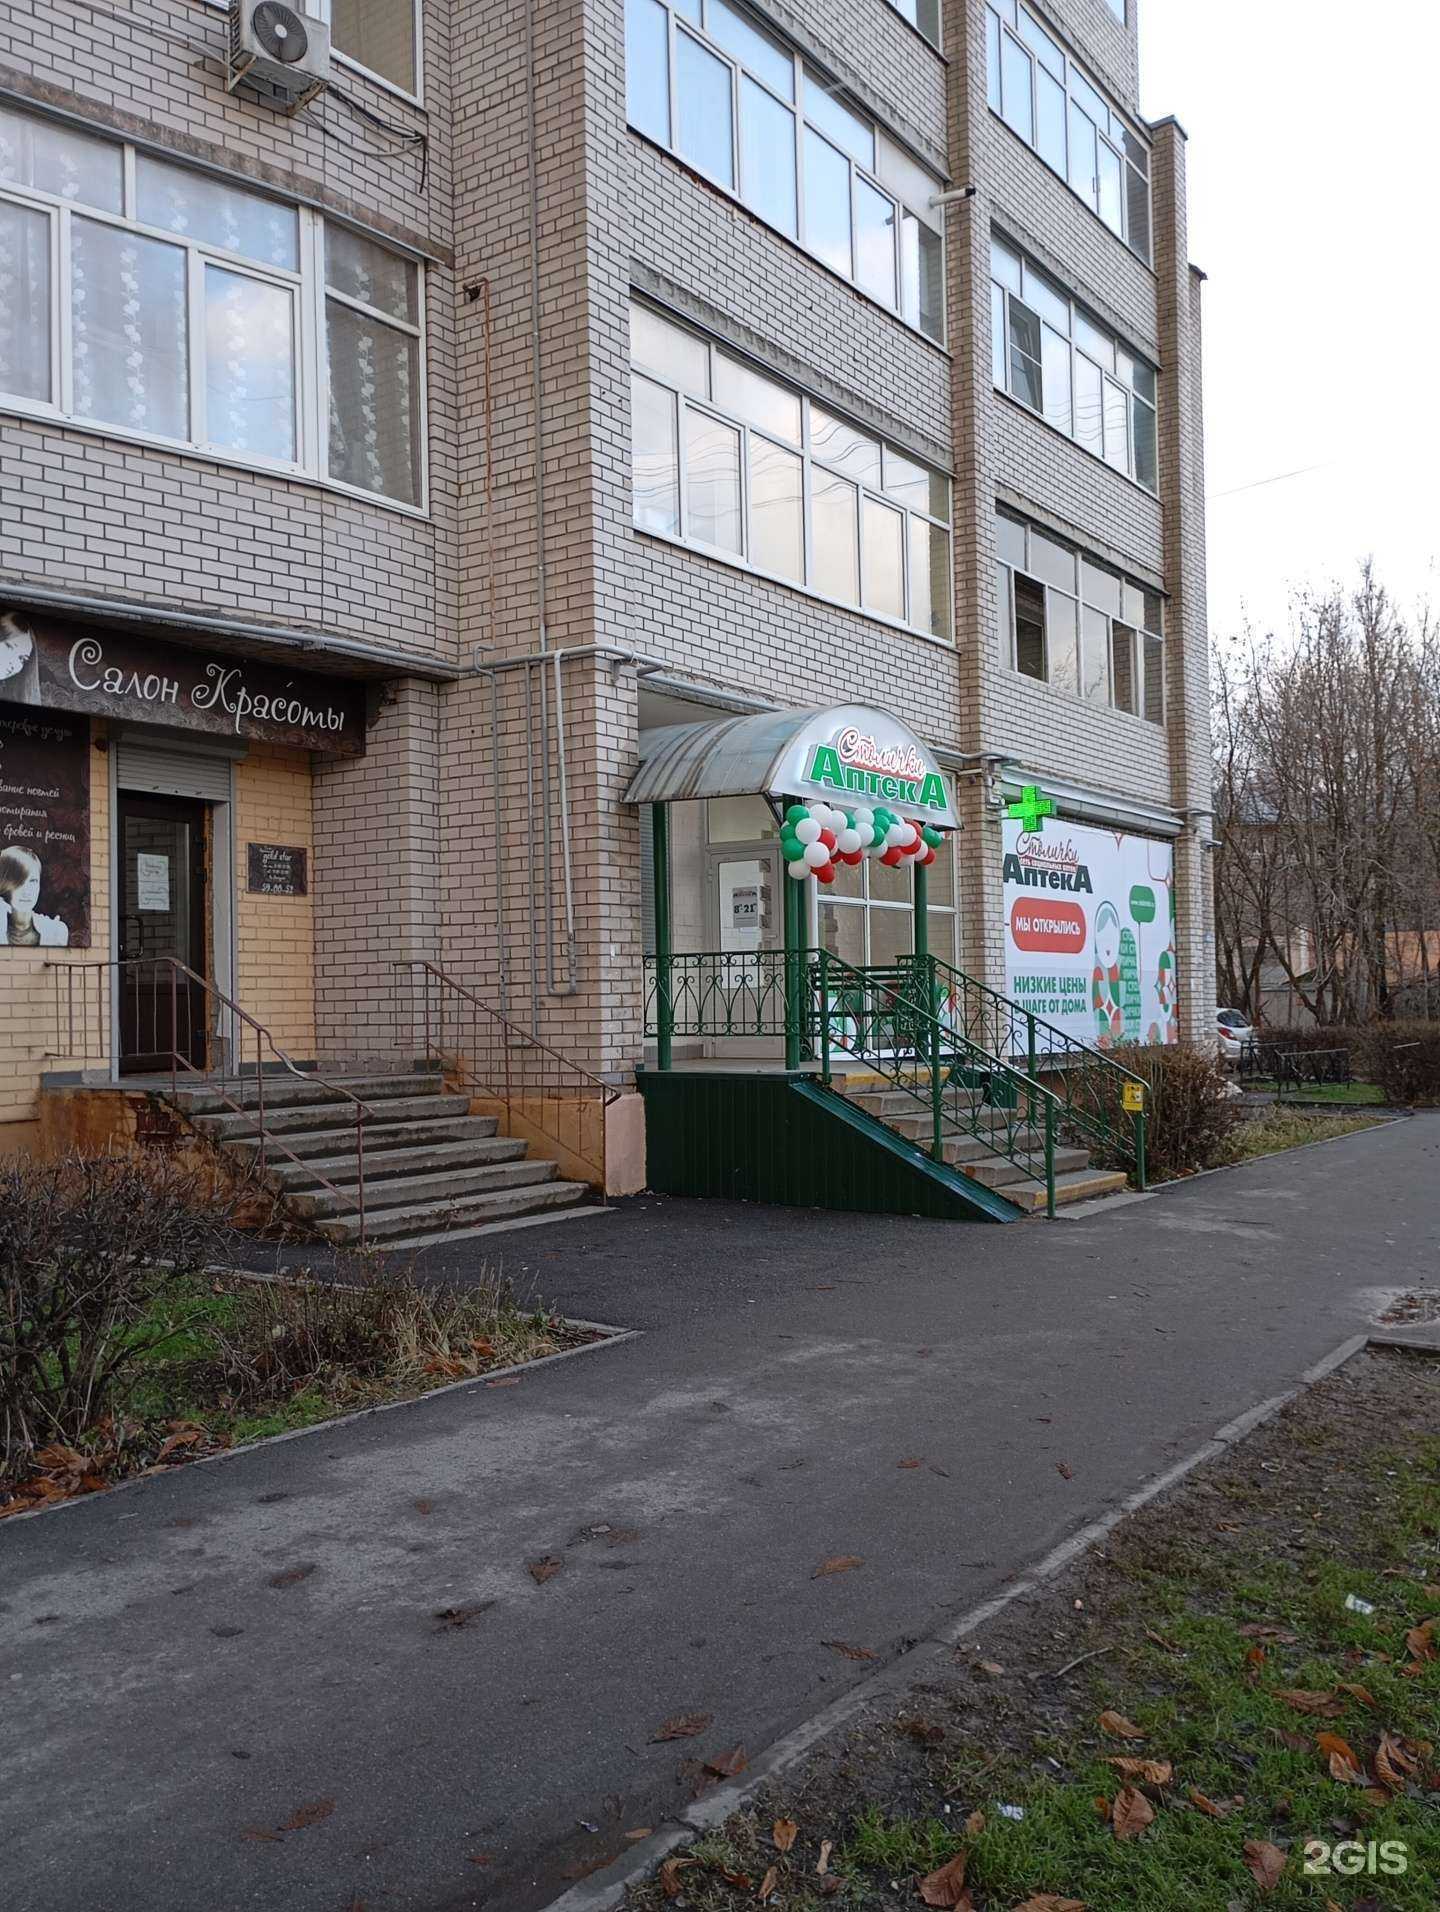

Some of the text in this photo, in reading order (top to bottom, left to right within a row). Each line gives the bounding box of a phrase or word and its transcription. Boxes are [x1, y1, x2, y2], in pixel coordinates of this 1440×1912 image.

[69, 638, 345, 734] Салон Красоты
[809, 743, 949, 810] АптекА
[1003, 853, 1094, 894] АптекА
[1015, 916, 1081, 935] МЫ ОТКРЫЛИСЬ
[1013, 976, 1087, 996] НИЗКИЕ ЦЕНЫ
[1022, 998, 1047, 1014] ШАГЕ
[1048, 998, 1060, 1014] ОТ
[1061, 999, 1087, 1015] ДОМА
